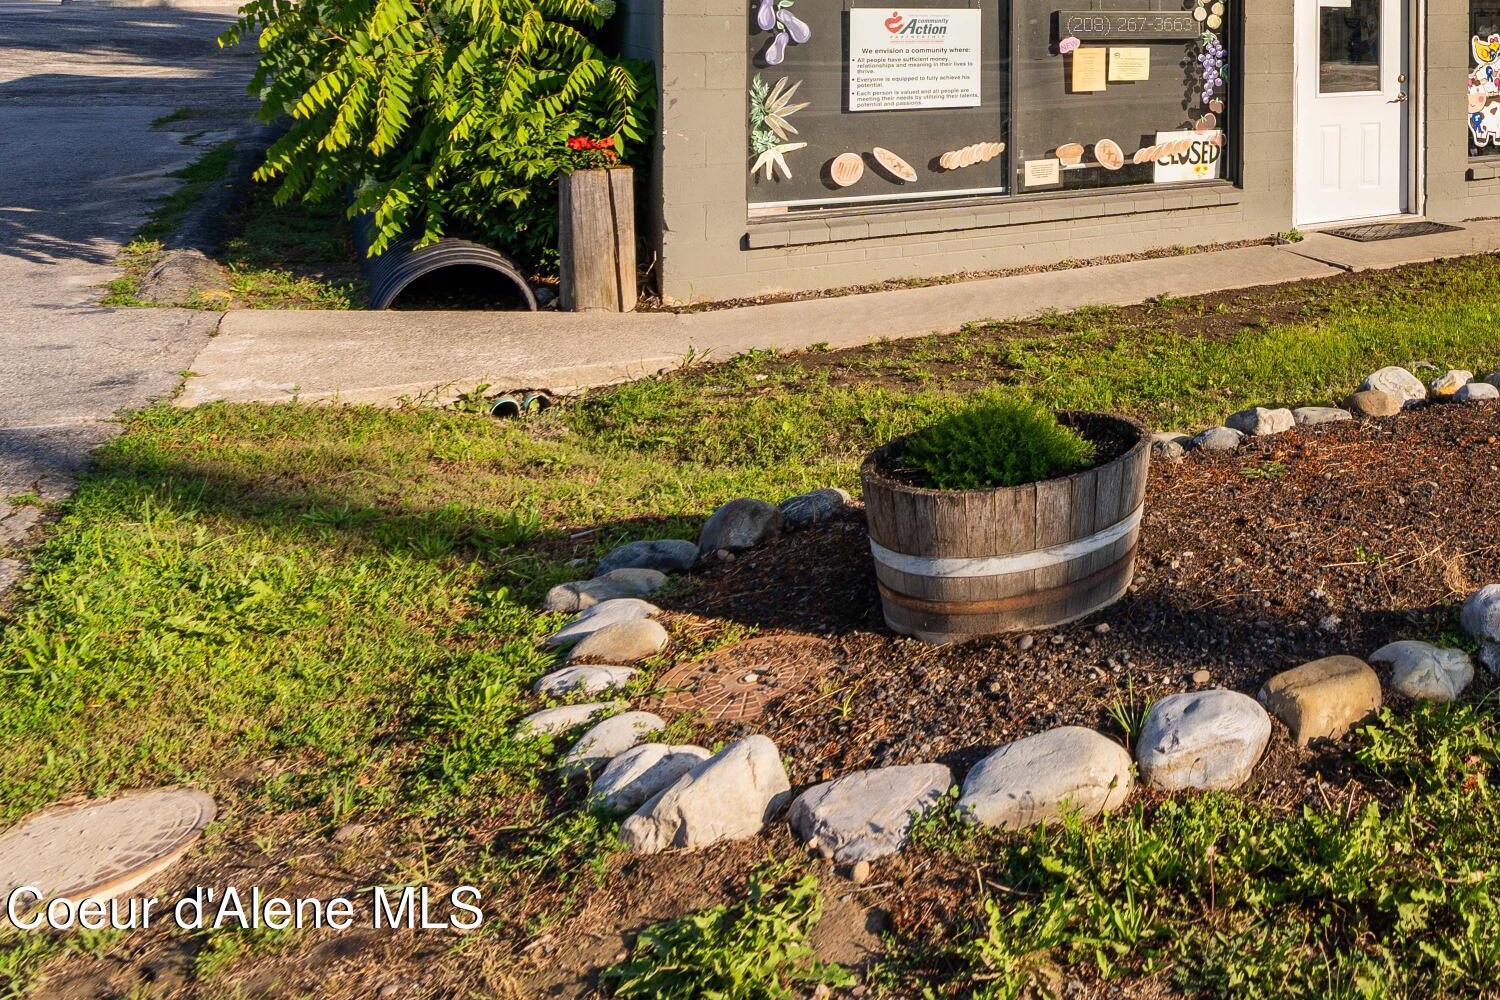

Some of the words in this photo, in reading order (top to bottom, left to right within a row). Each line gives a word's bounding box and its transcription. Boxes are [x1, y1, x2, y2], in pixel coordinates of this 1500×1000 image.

[899, 19, 947, 34] Action
[1067, 15, 1112, 37] (208)
[1117, 17, 1193, 32] 267-3663
[911, 47, 948, 55] community
